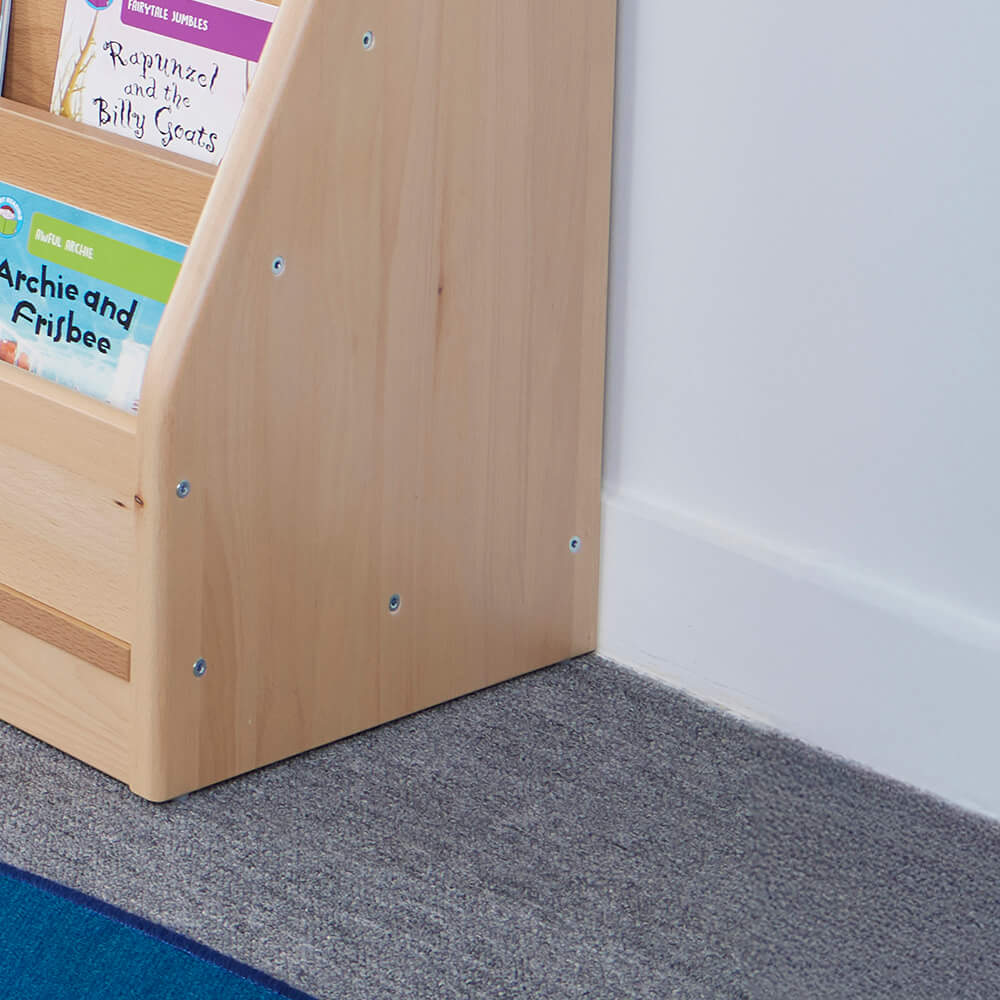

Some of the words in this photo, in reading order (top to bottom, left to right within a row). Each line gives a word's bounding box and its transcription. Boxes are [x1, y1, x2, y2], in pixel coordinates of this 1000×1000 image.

[171, 11, 208, 31] JUMBLES
[102, 41, 219, 91] Rapunzel
[124, 78, 156, 99] and
[164, 82, 191, 109] the
[94, 98, 145, 139] Billy
[155, 106, 218, 152] Goats
[35, 229, 62, 248] AWFUL
[64, 240, 95, 259] ARCHIE
[11, 300, 111, 354] Frisbee
[84, 290, 138, 331] and
